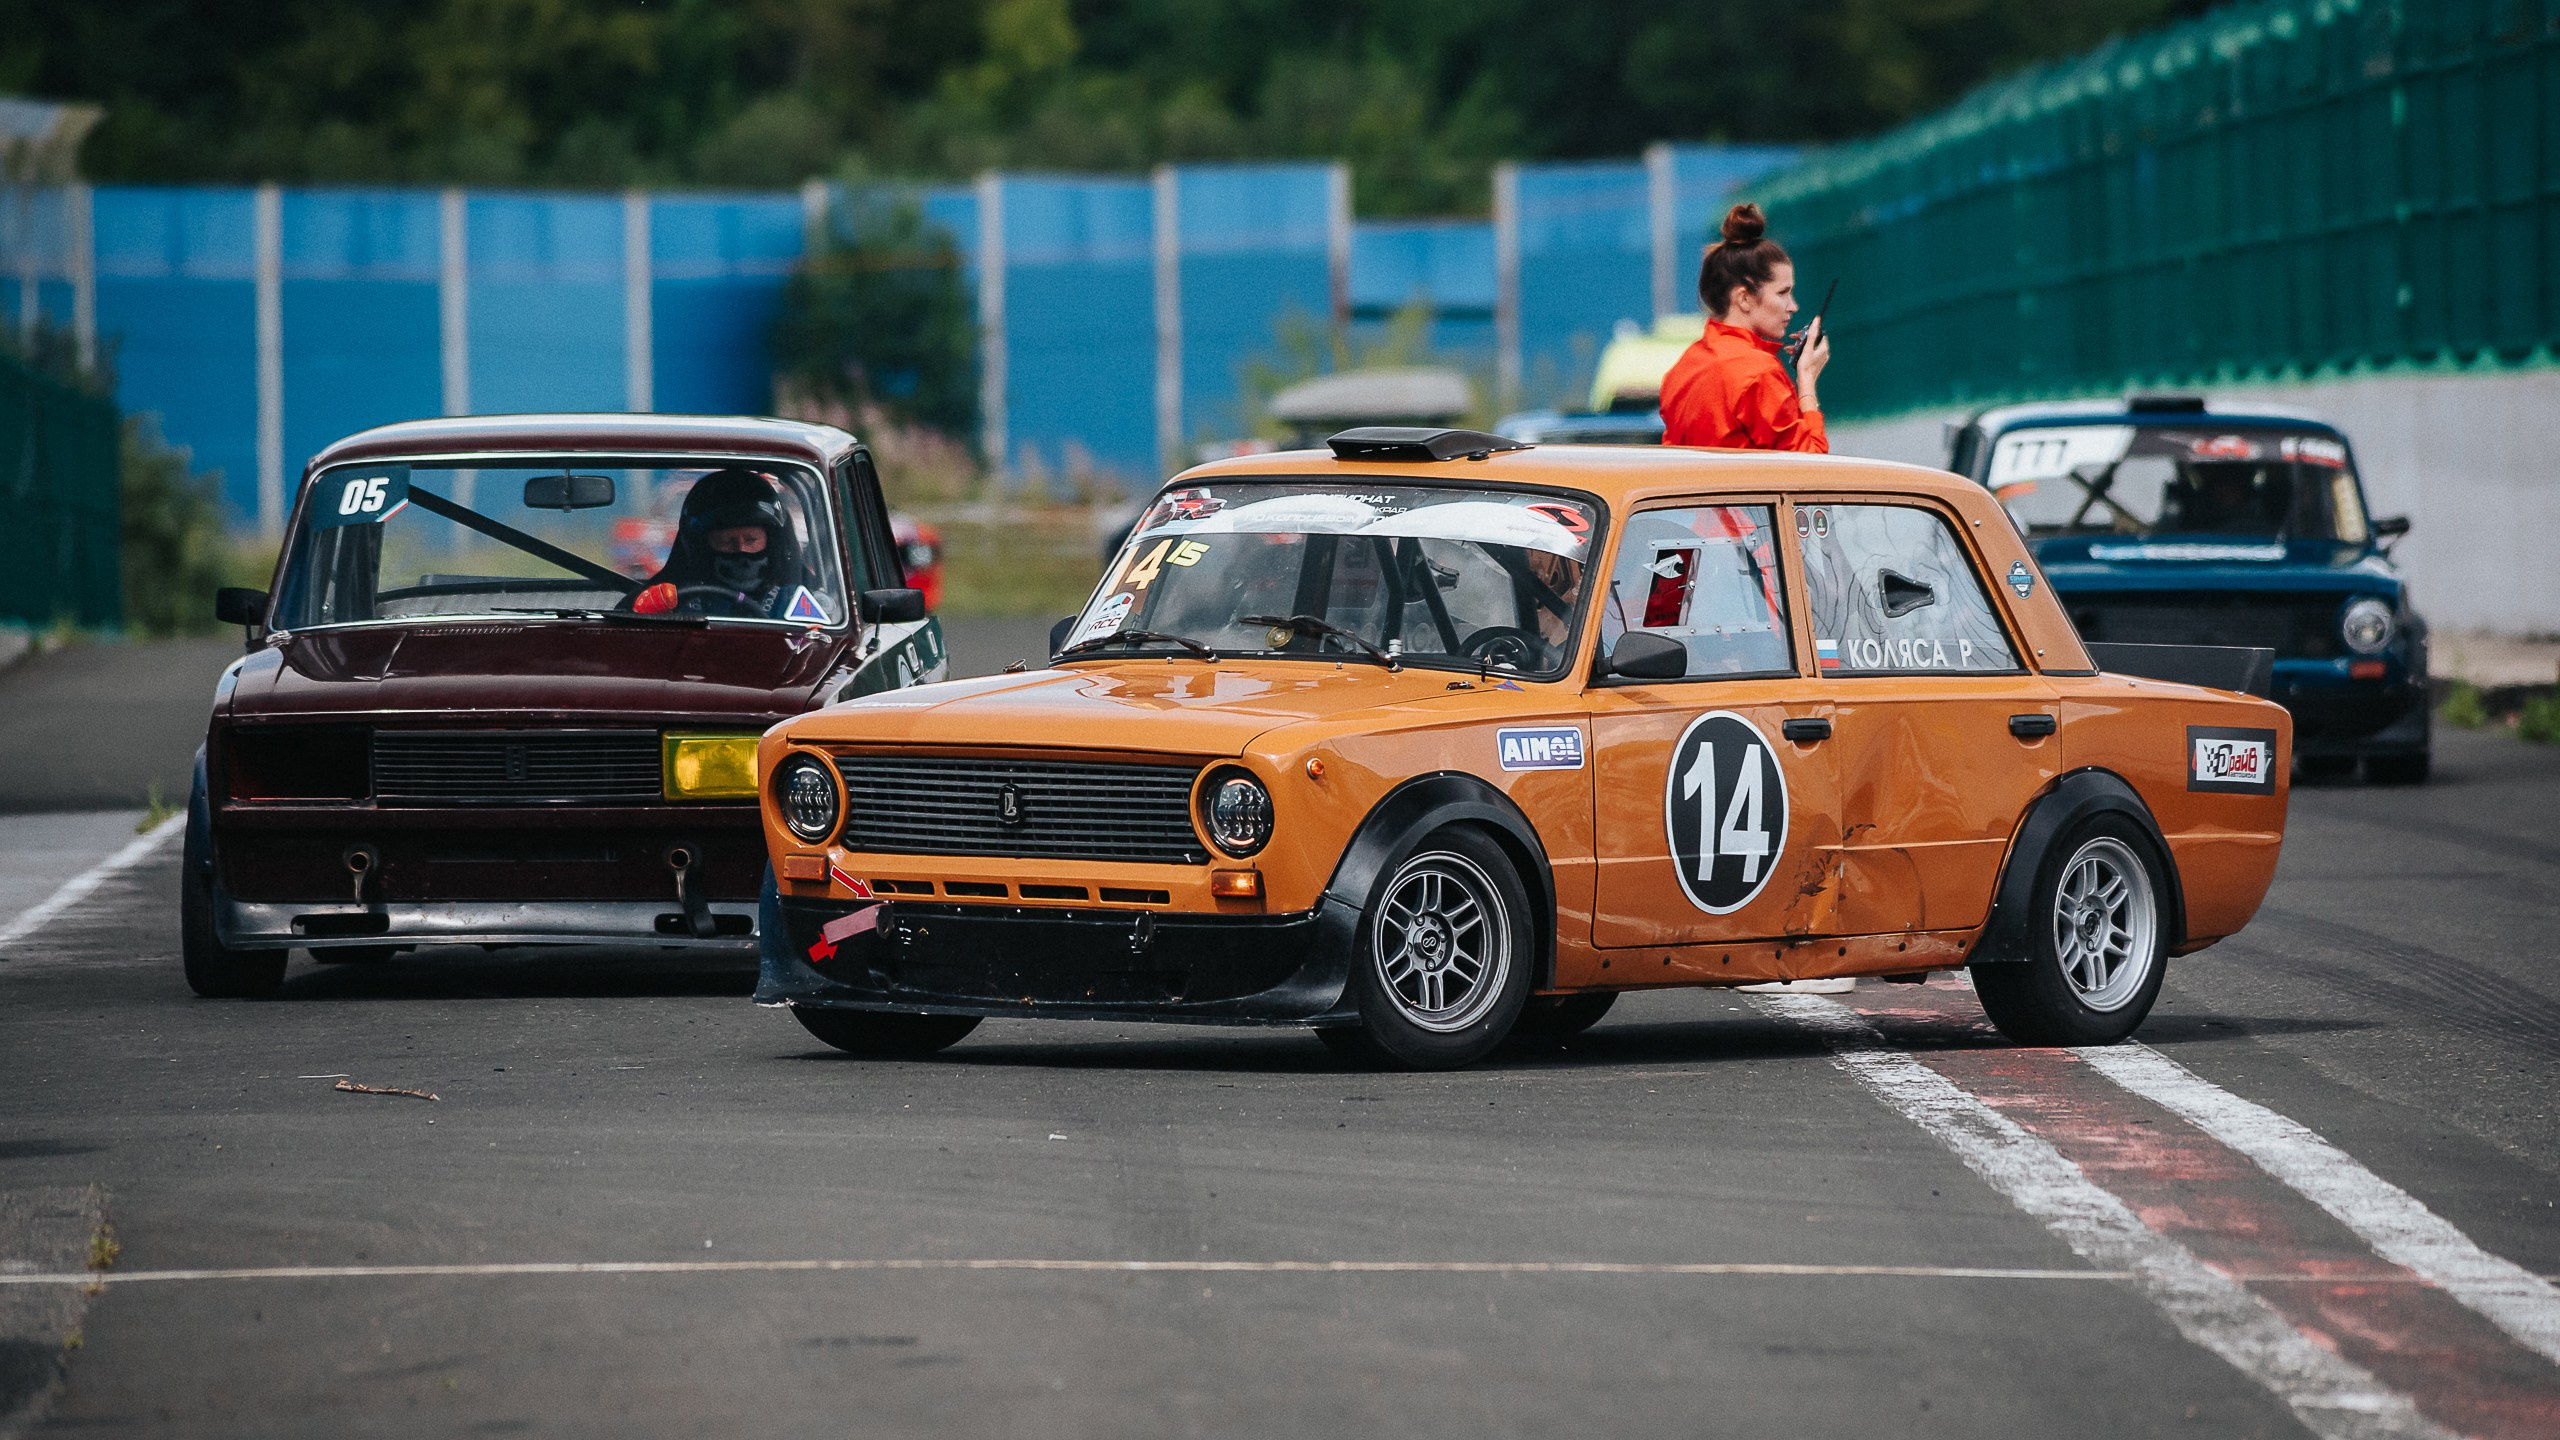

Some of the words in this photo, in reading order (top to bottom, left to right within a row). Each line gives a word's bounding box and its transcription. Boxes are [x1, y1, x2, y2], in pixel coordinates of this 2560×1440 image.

[2010, 440, 2068, 471] 777
[338, 477, 390, 516] 05
[1166, 540, 1210, 567] 15
[1848, 638, 1949, 668] КОЛЯСА
[1959, 638, 1973, 668] Р
[1503, 736, 1581, 763] AIMOL
[1683, 741, 1770, 882] 14
